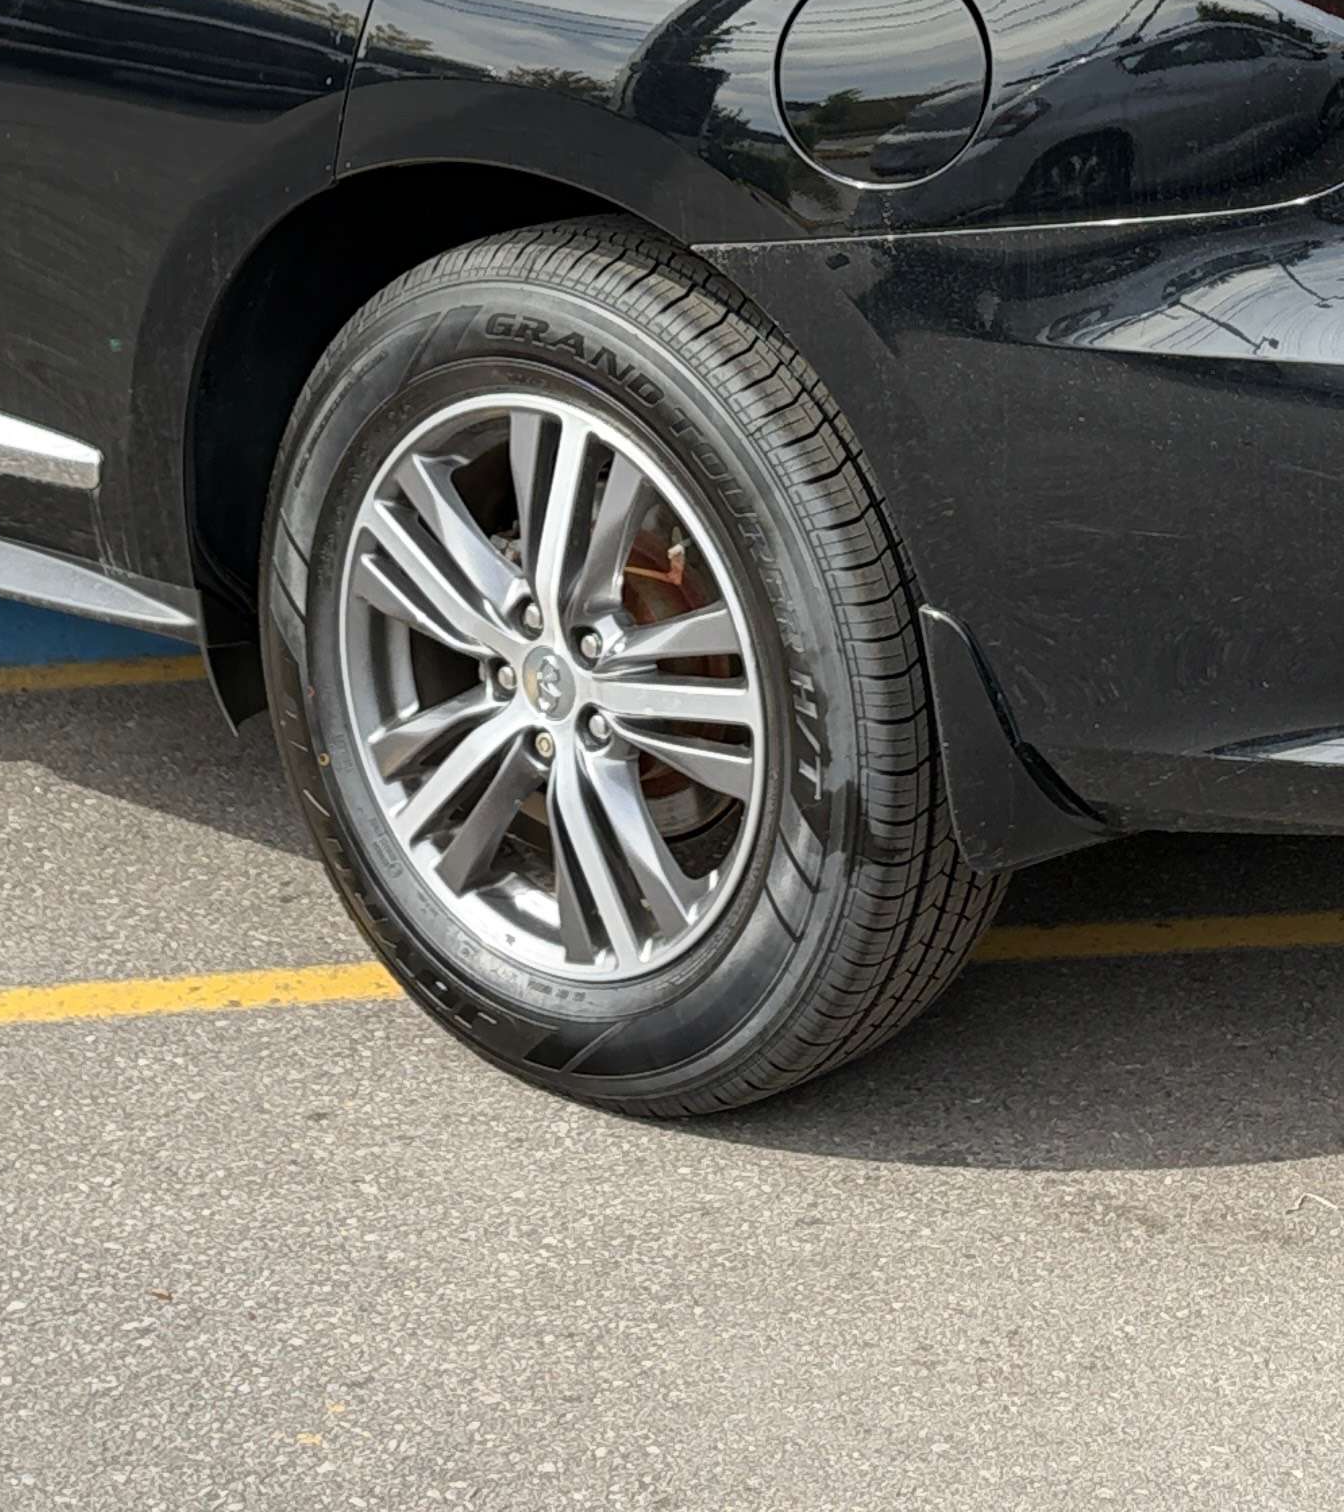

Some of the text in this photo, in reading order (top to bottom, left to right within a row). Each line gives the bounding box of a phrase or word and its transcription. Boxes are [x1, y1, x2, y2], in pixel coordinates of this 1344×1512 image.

[485, 312, 824, 802] GRAND TOURER H/T
